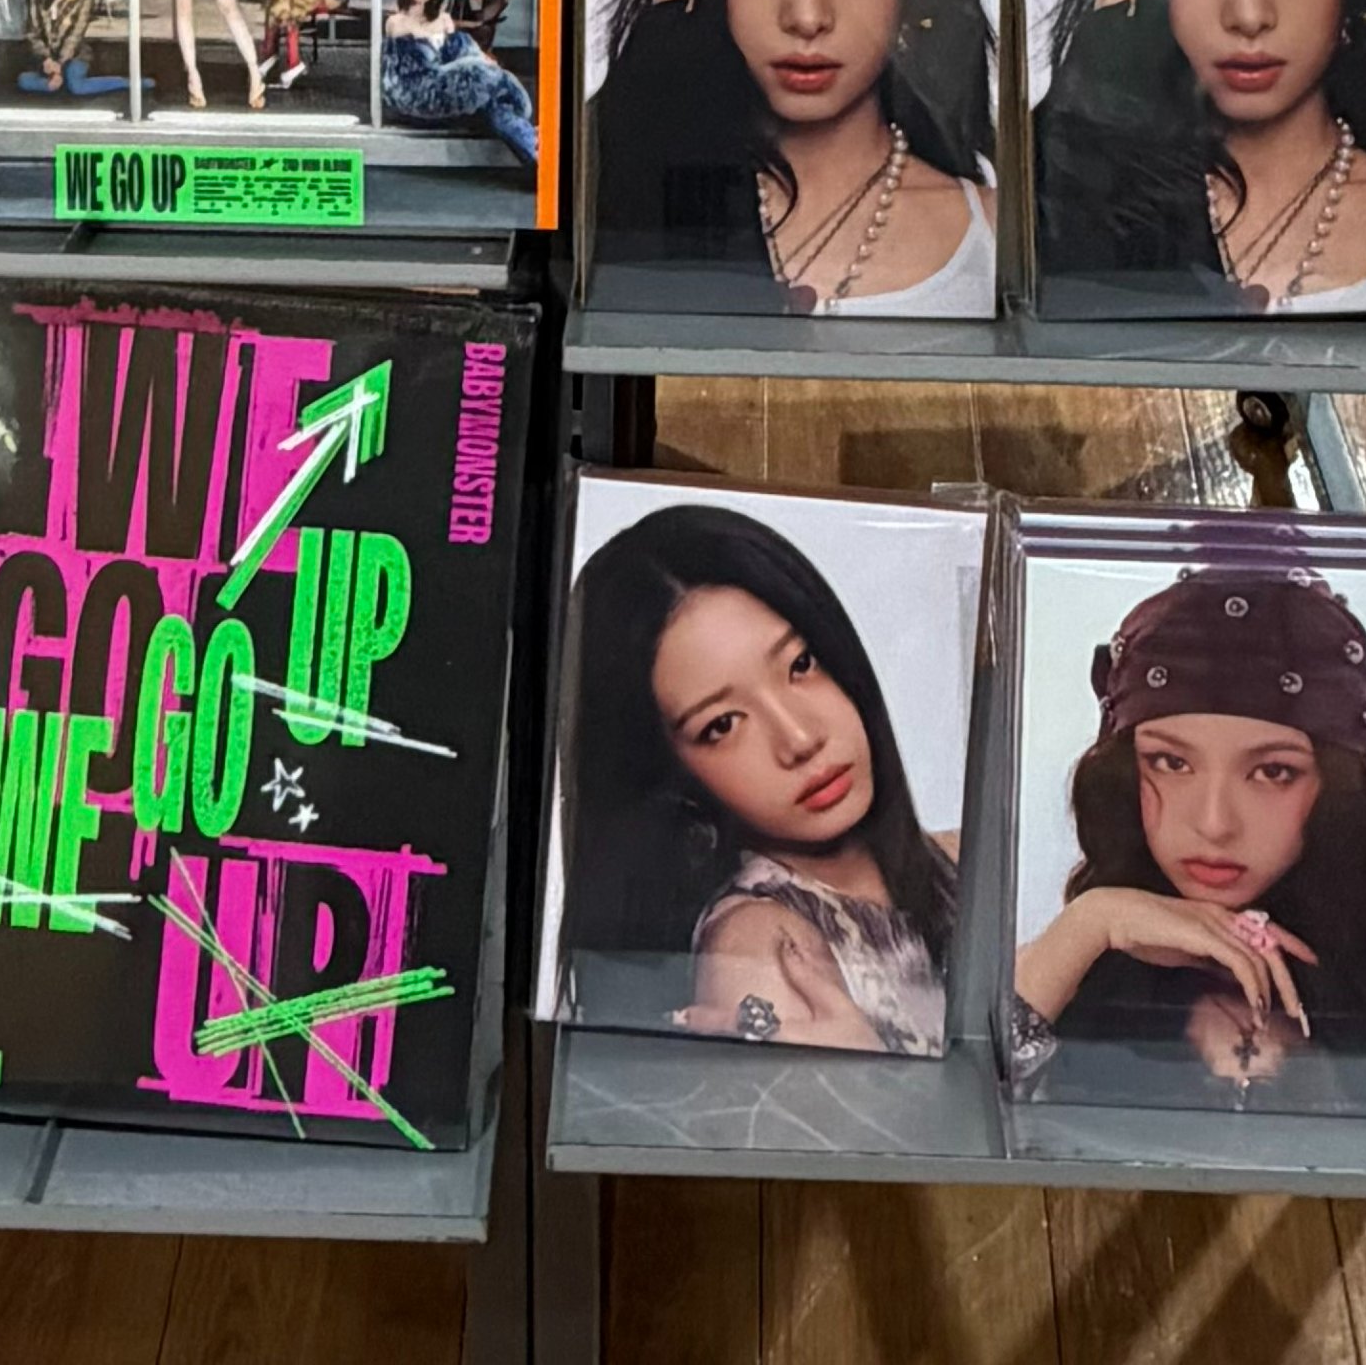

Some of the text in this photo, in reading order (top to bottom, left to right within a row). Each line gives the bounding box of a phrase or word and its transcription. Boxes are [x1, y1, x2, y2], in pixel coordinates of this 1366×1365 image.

[65, 150, 104, 213] WE
[109, 151, 146, 213] GO
[151, 152, 187, 214] UP
[448, 341, 508, 545] BABYMONSTER
[133, 614, 256, 838] GO
[287, 527, 413, 748] UP
